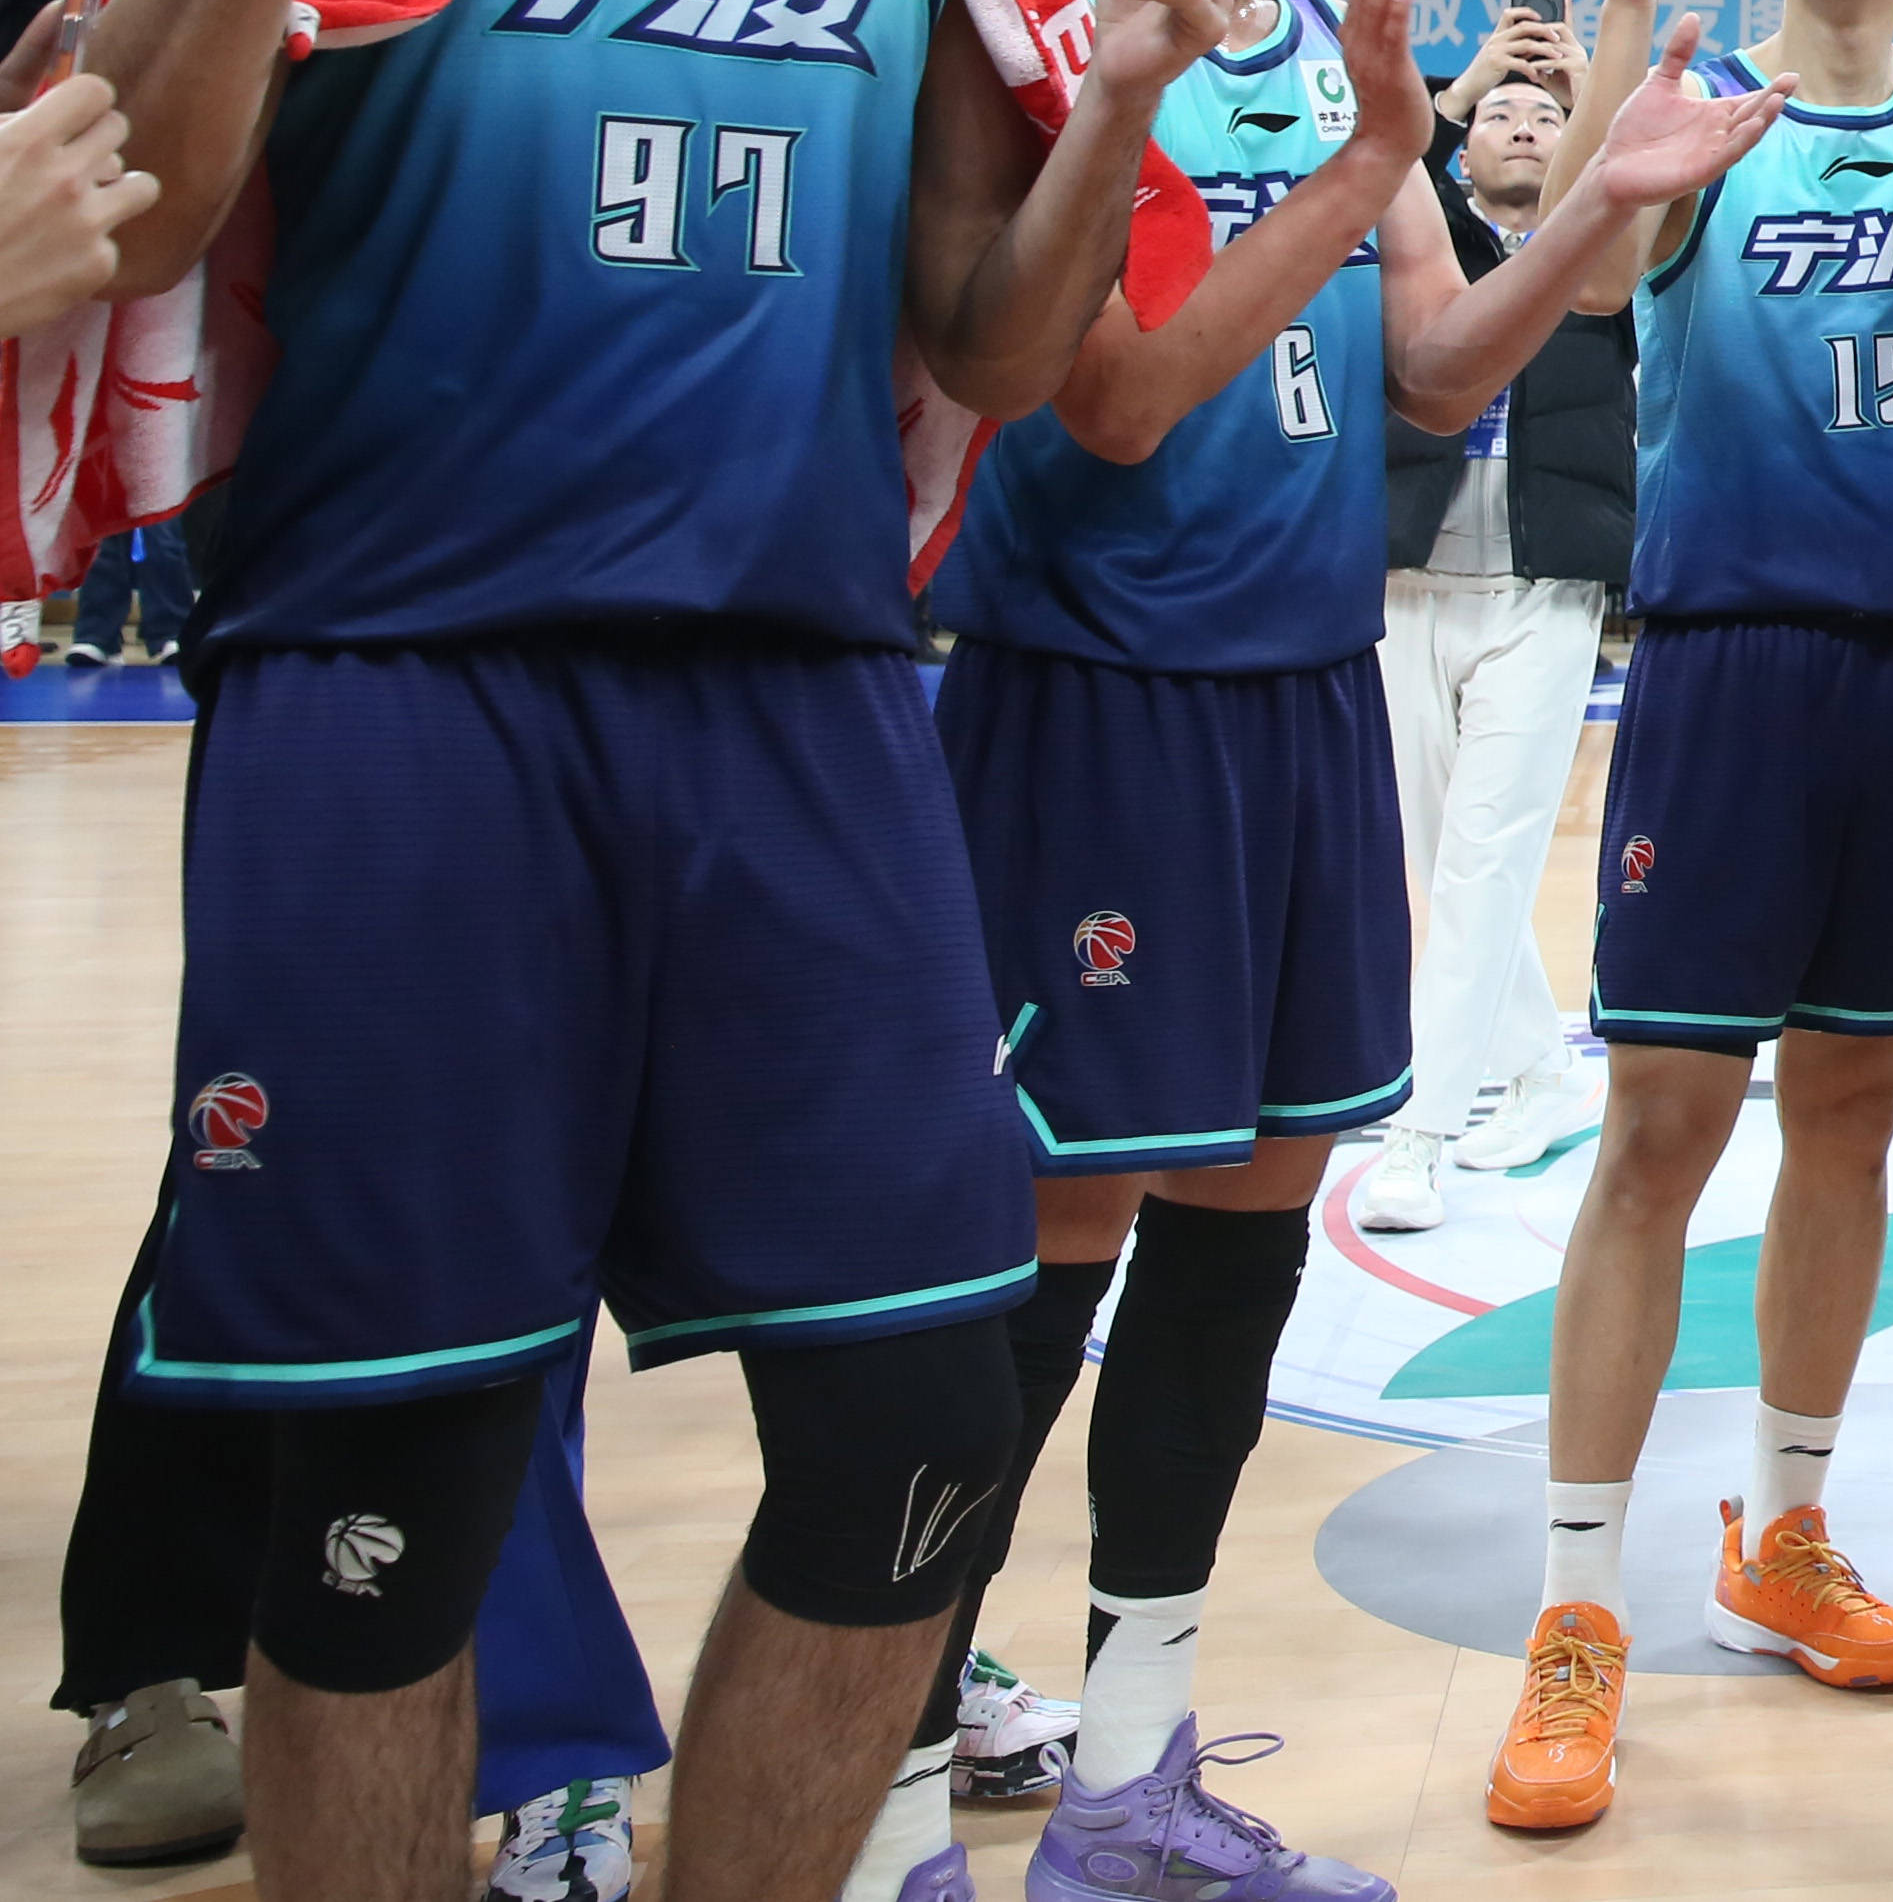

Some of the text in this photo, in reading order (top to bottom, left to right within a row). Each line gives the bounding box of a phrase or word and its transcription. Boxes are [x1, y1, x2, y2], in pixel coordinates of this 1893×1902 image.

[596, 114, 804, 274] 97
[1273, 325, 1336, 441] 6
[1081, 970, 1131, 987] CBA
